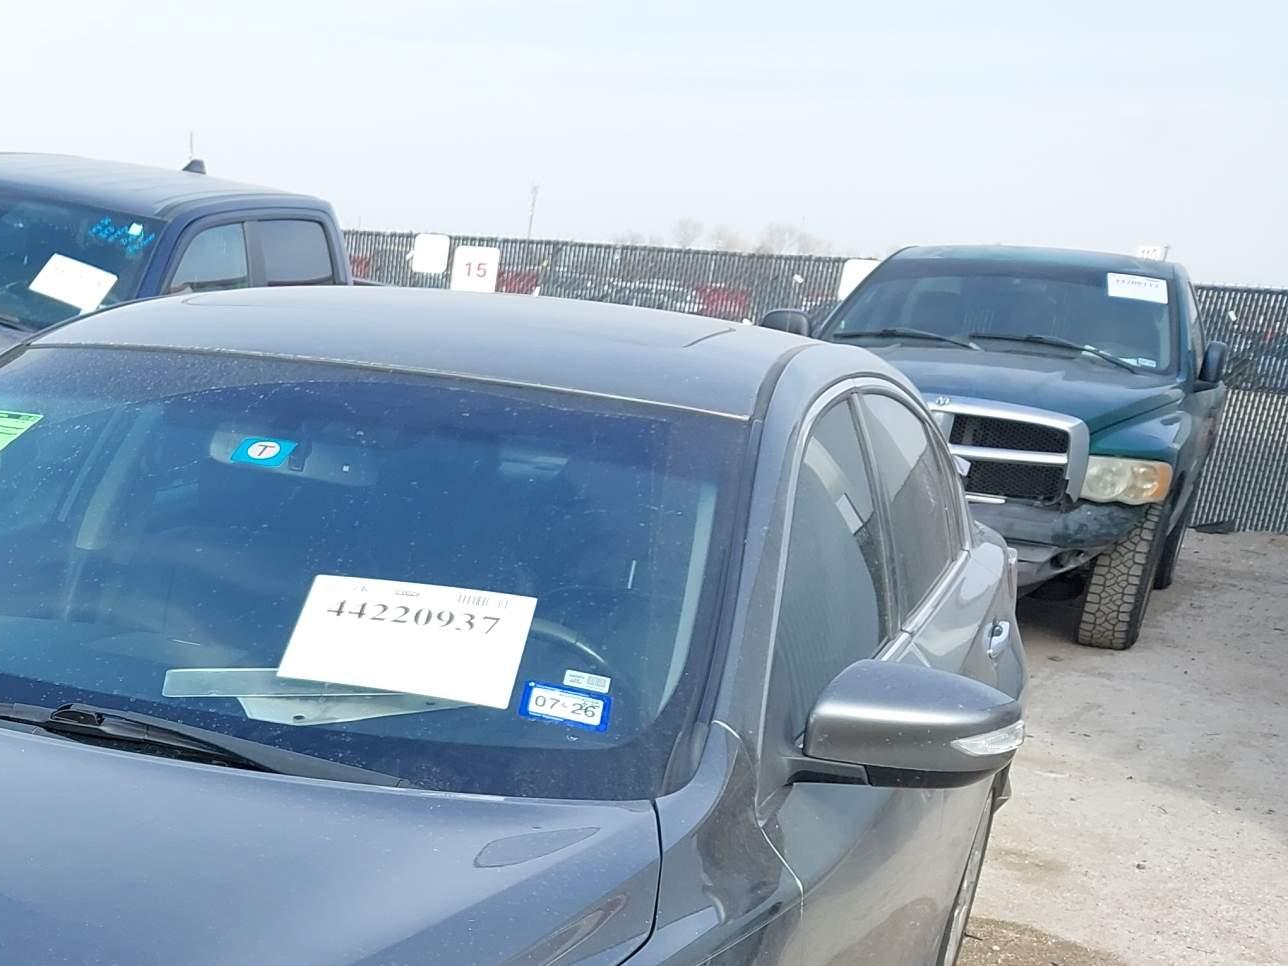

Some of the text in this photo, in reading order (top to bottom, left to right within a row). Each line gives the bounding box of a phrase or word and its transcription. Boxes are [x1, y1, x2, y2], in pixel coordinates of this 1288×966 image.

[465, 261, 488, 278] 15
[258, 444, 276, 457] T
[326, 598, 501, 634] 44220937
